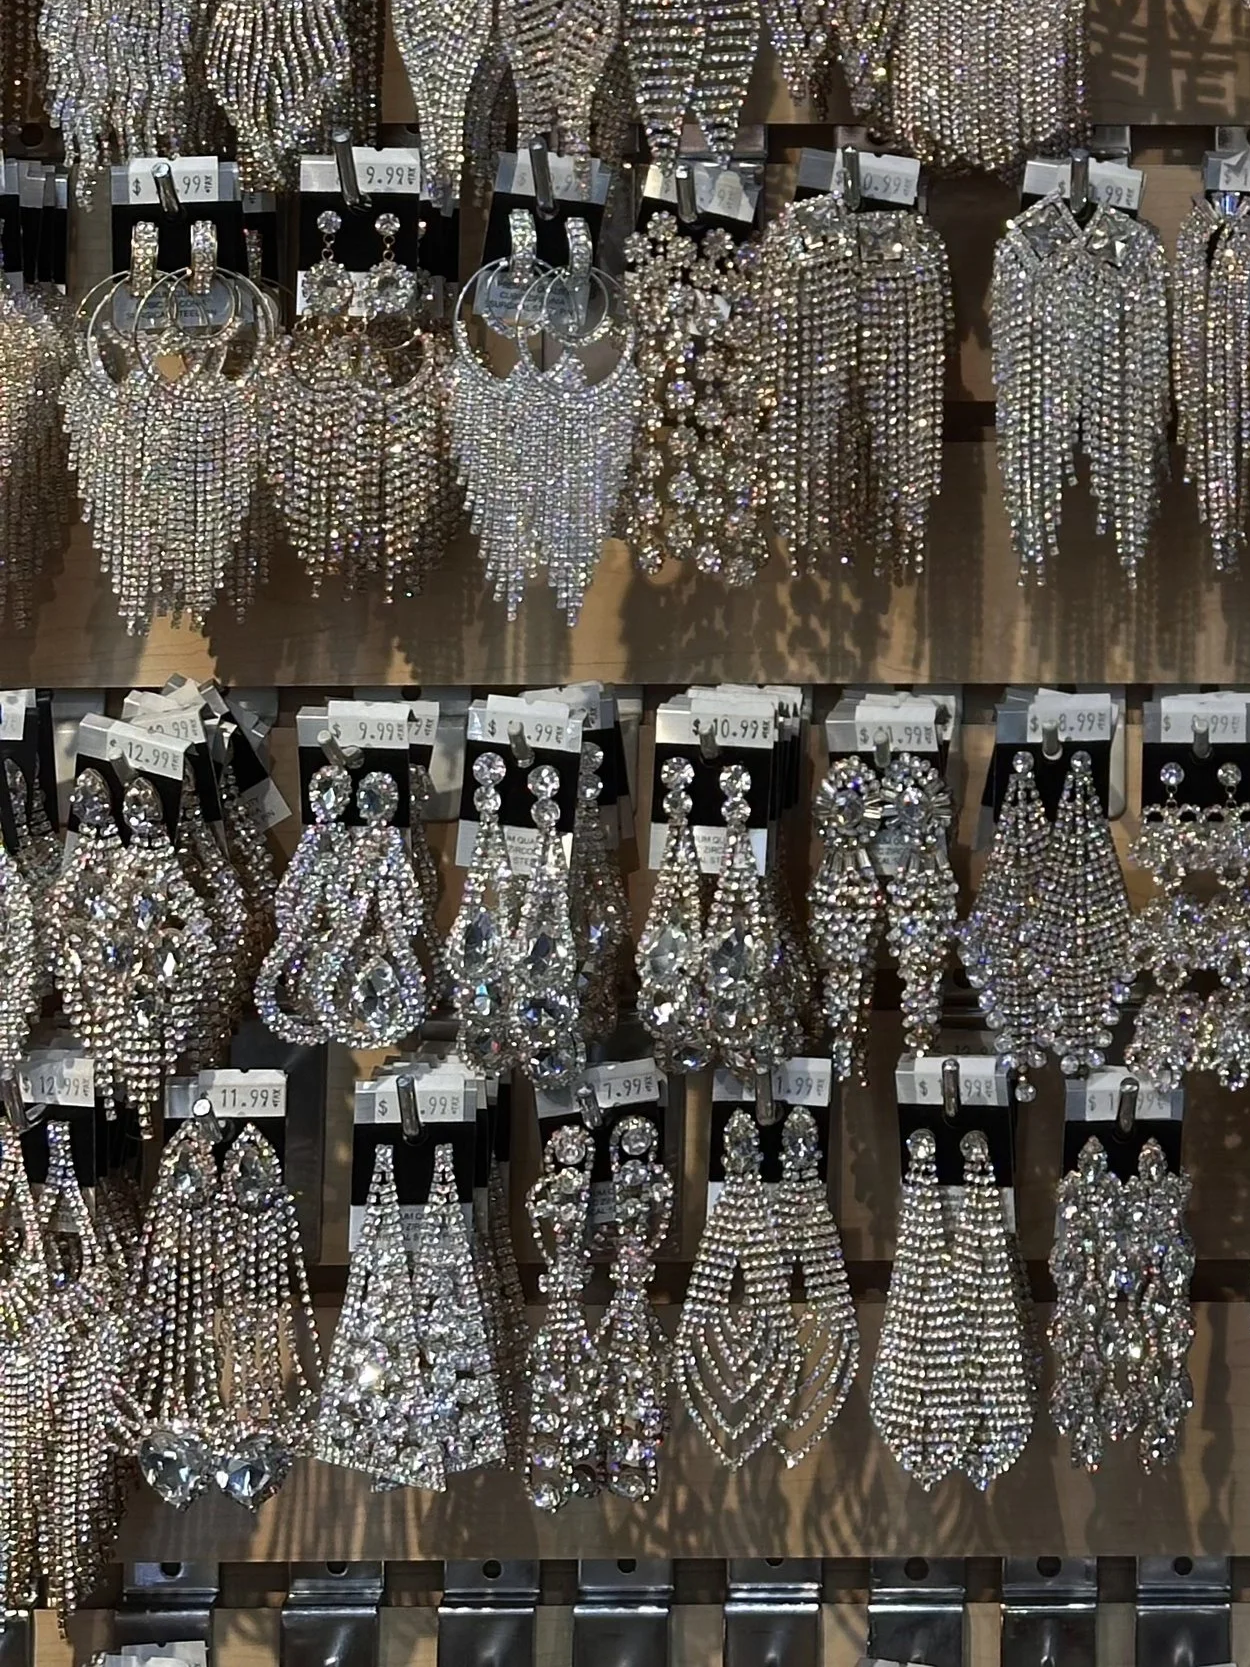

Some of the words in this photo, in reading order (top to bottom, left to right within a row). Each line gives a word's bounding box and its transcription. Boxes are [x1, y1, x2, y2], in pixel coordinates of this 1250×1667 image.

[366, 166, 402, 186] 9.99
[359, 722, 394, 741] 9.99
[127, 741, 170, 763] 12.99
[39, 1076, 79, 1098] 12.99
[603, 1079, 641, 1099] 7.99
[221, 1089, 269, 1107] 11.99
